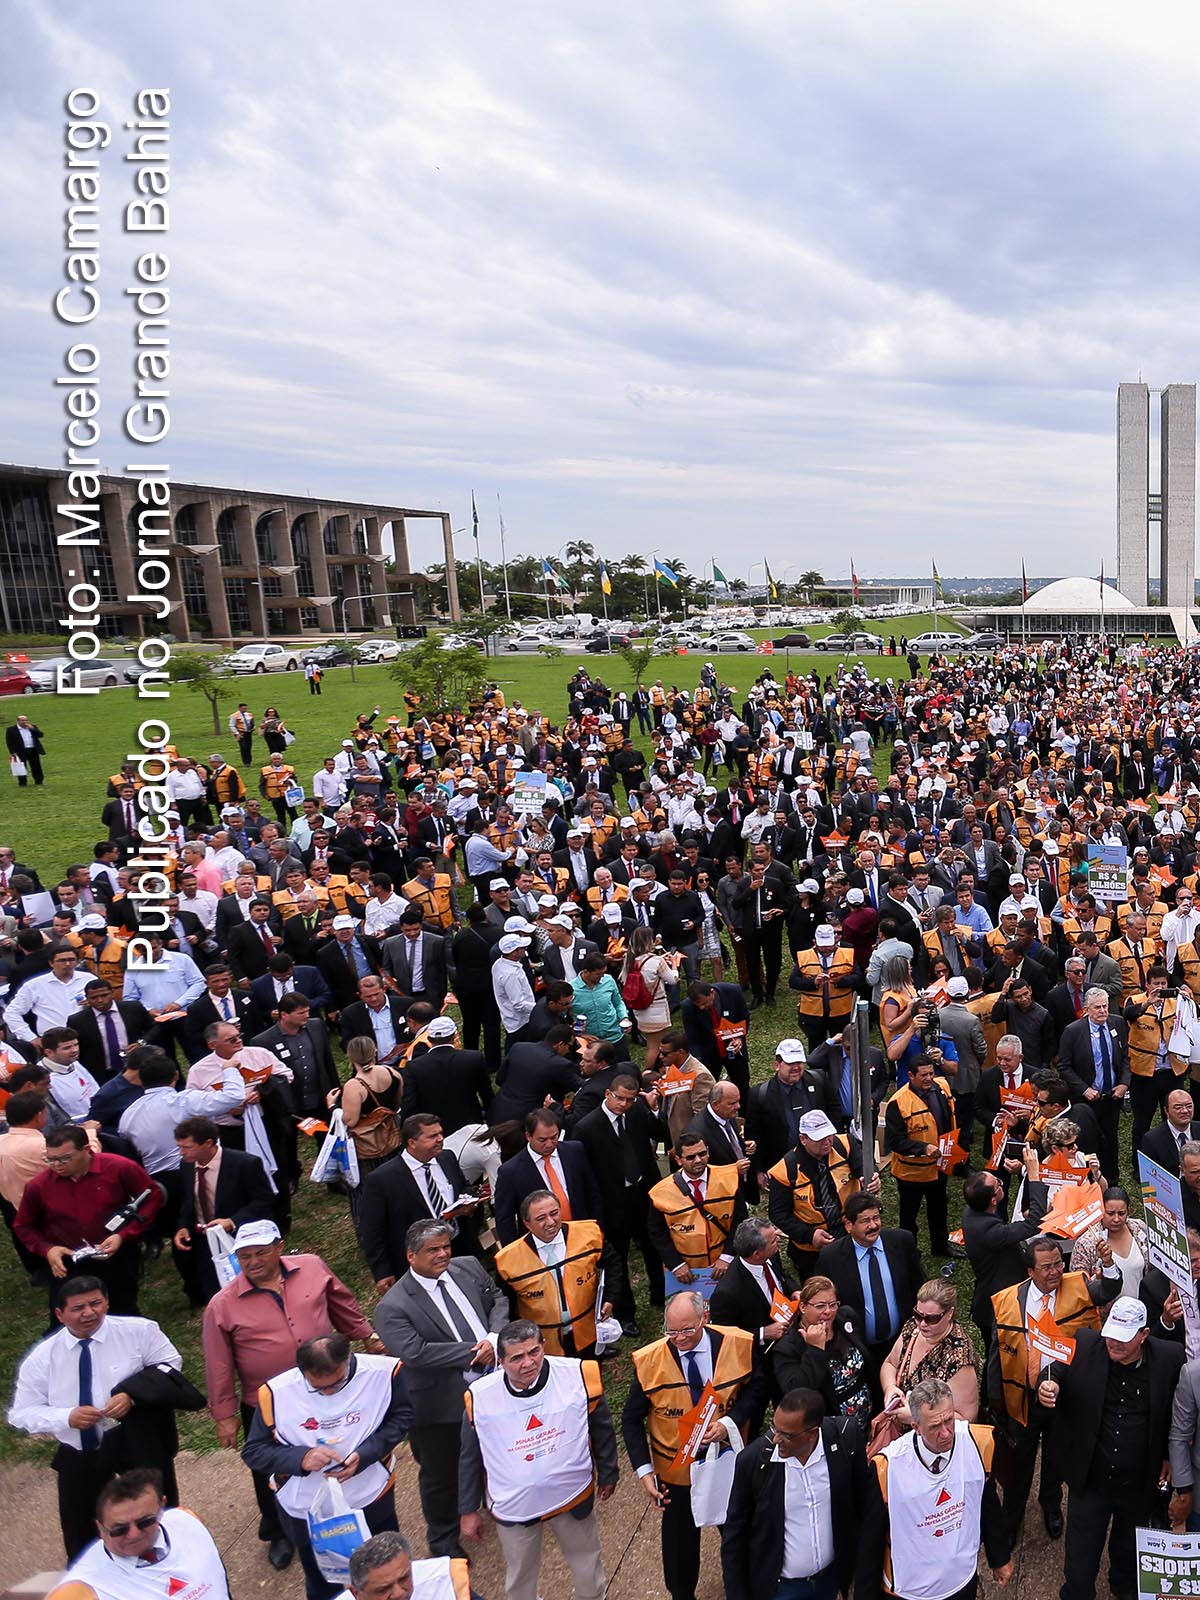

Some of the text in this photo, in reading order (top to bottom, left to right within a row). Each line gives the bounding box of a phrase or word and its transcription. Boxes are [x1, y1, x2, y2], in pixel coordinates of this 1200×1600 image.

[1111, 872, 1118, 881] 4
[1090, 880, 1126, 890] BILHÕES
[681, 1224, 695, 1232] CNM
[1155, 1216, 1179, 1246] R$ 4
[1148, 1227, 1190, 1272] BILHÕES
[527, 1289, 545, 1298] CNM
[664, 1408, 684, 1417] CNM
[516, 1428, 557, 1446] MINAS GERAIS
[925, 1501, 966, 1521] MINAS GERAIS
[320, 1522, 358, 1539] MARCHA
[1160, 1578, 1174, 1594] 4
